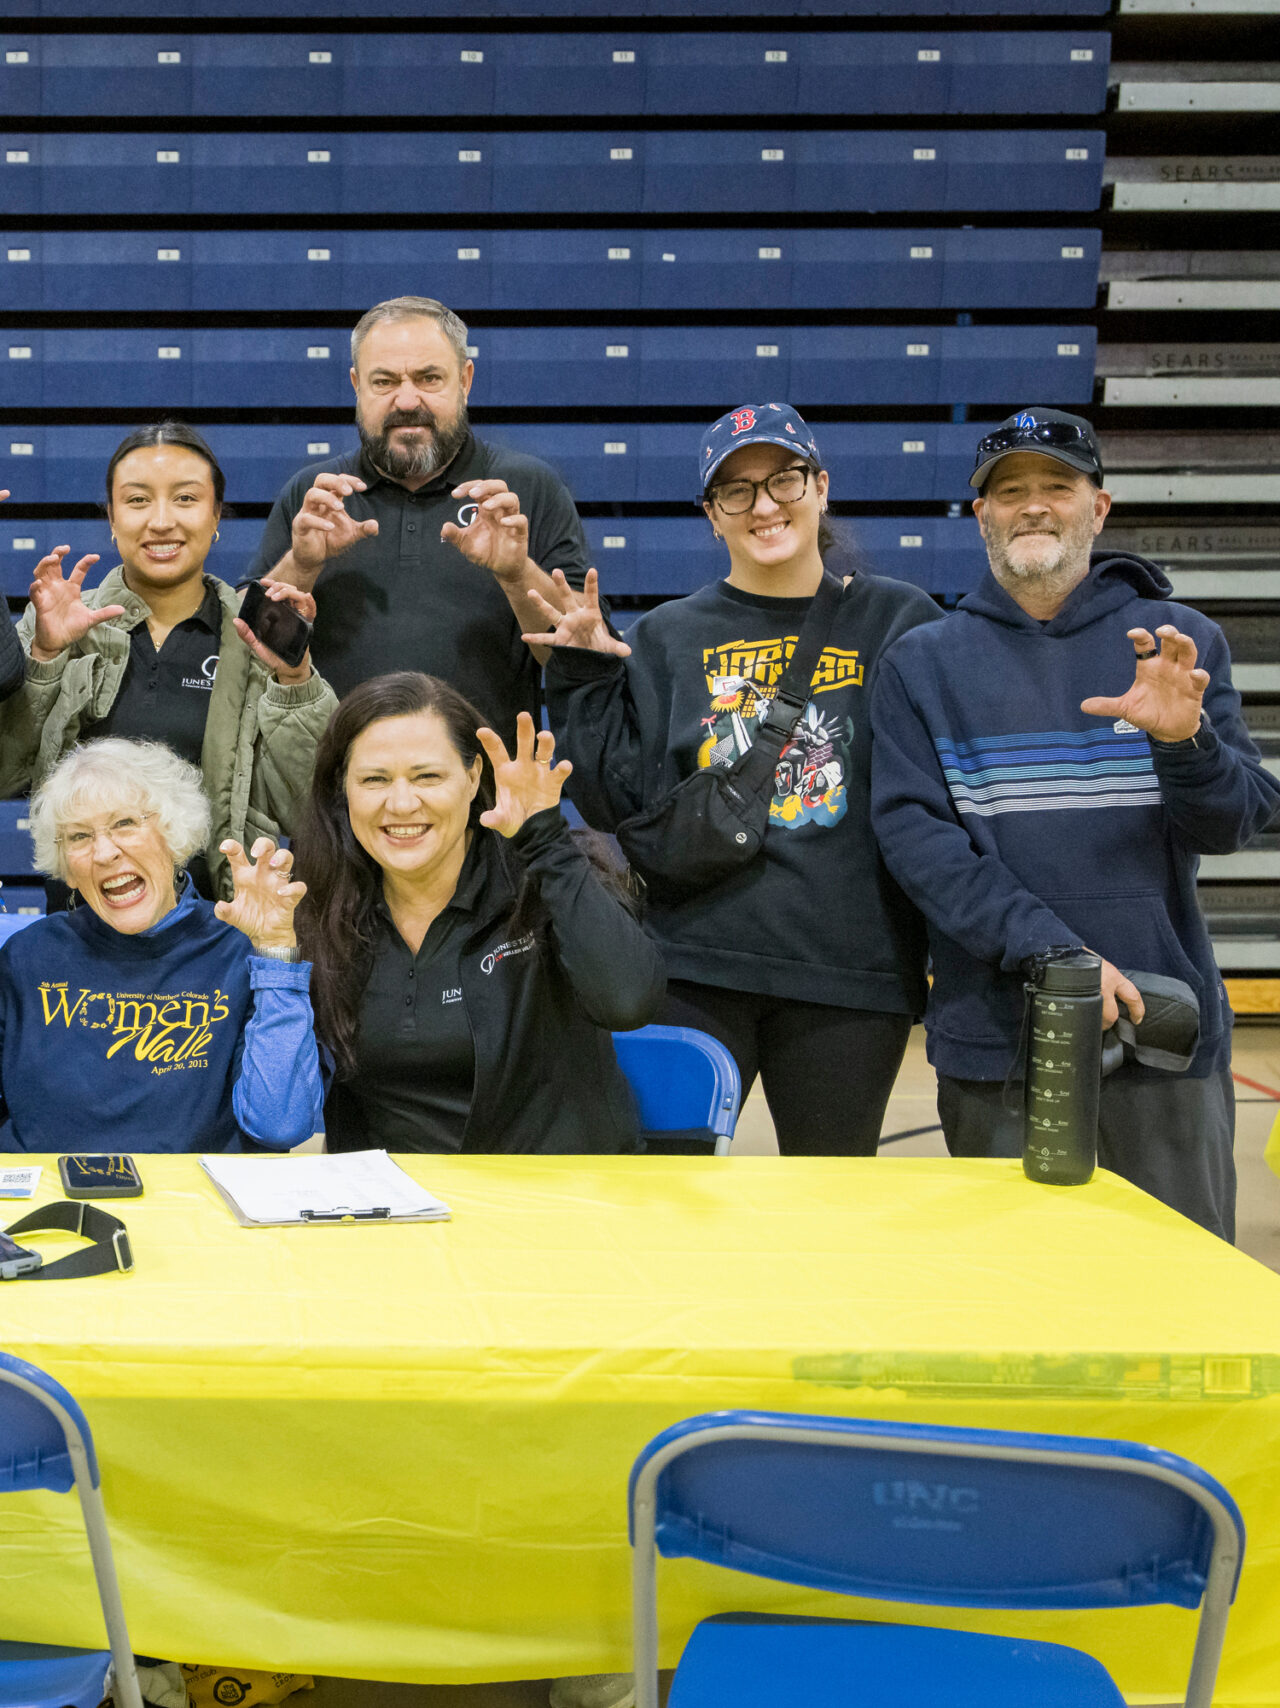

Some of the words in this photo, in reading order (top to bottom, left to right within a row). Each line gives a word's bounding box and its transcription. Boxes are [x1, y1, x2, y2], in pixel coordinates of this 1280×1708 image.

[1160, 165, 1233, 180] SEARS
[1152, 354, 1224, 368] SEARS
[730, 408, 757, 436] B
[1140, 536, 1213, 551] SEARS
[116, 992, 145, 1001] University
[181, 990, 209, 1001] Colorado
[37, 988, 230, 1031] Women's
[106, 1021, 213, 1063] Walk
[151, 1063, 172, 1076] April
[173, 1062, 186, 1073] 20,
[187, 1059, 209, 1070] 2013
[873, 1481, 980, 1512] UNC
